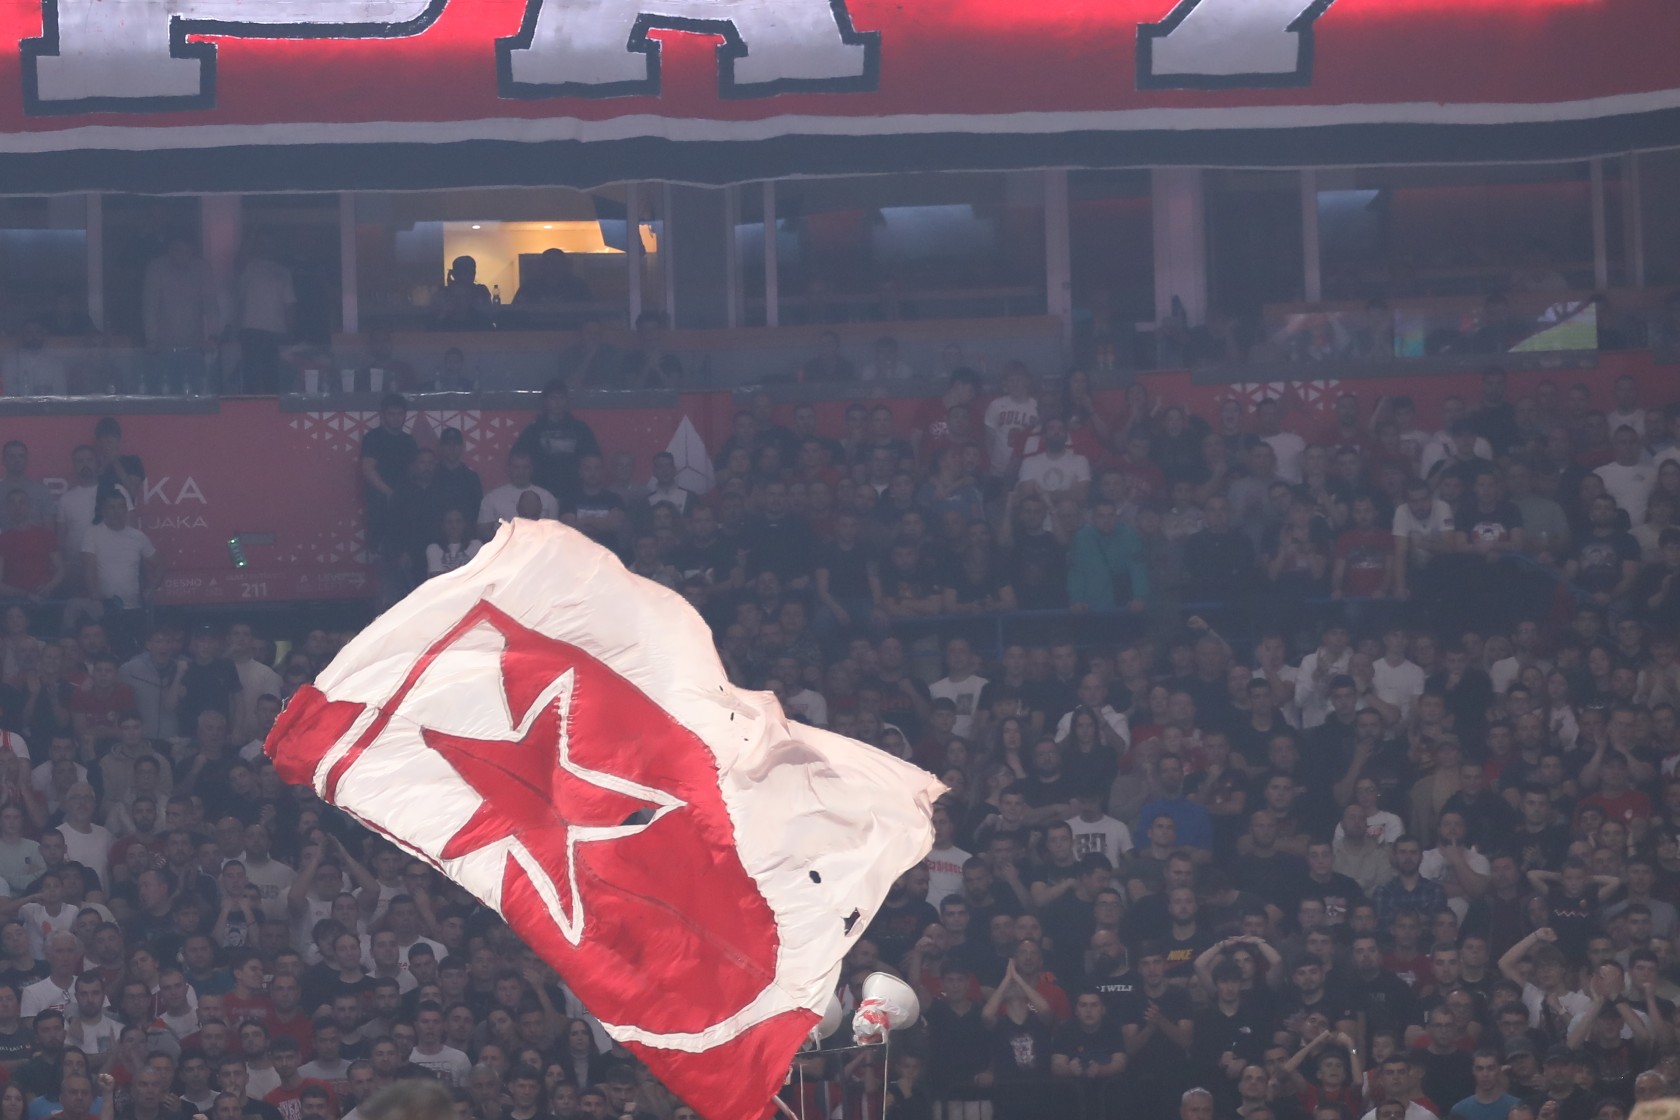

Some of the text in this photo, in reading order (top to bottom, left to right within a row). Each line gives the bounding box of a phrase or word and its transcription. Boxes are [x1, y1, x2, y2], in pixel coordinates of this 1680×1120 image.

[147, 515, 209, 529] JAKA
[165, 577, 203, 588] DESNO
[240, 582, 268, 599] 211
[1167, 949, 1194, 961] NIKE
